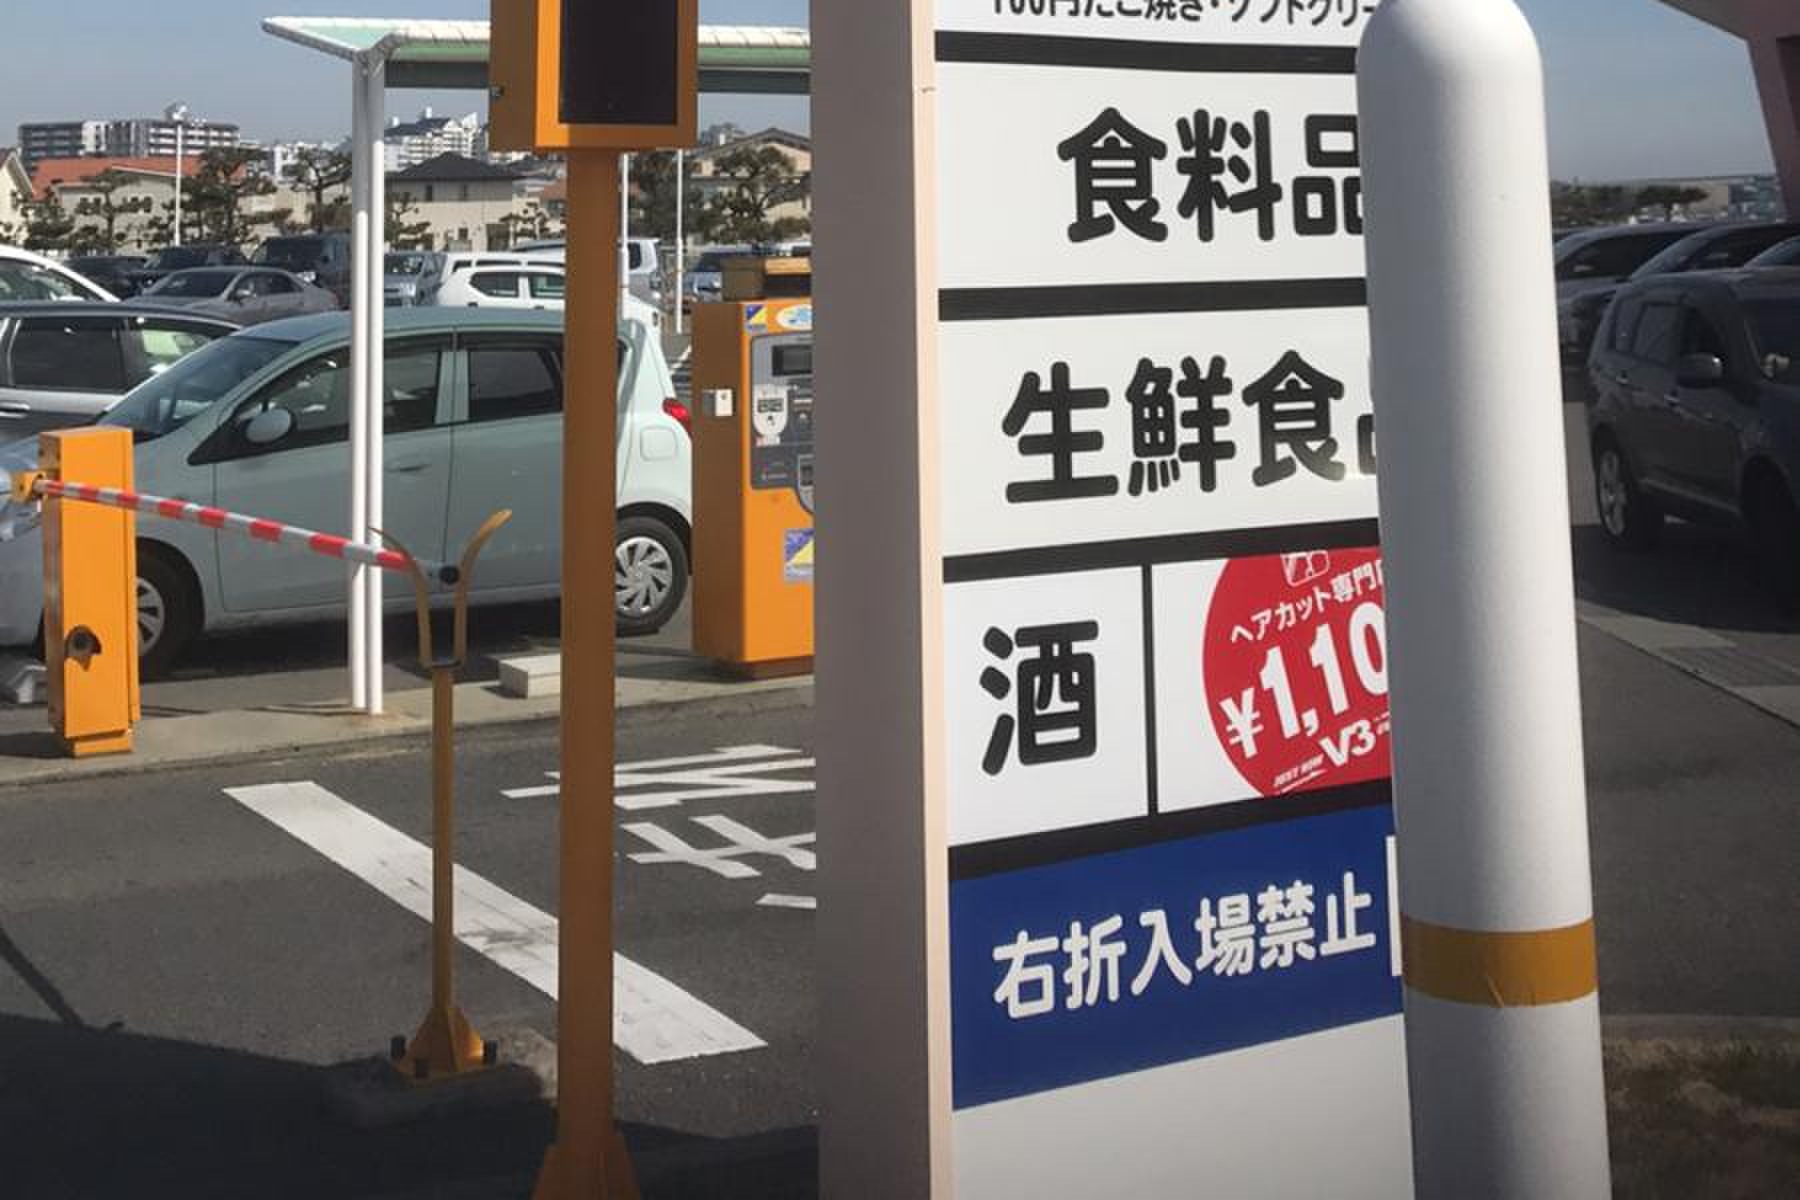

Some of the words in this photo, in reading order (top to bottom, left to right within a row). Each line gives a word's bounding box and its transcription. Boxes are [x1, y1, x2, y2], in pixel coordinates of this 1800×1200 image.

[1057, 107, 1364, 242] 食料品
[1002, 350, 1376, 503] 生鮮食
[1231, 560, 1382, 643] ヘアカット専門
[980, 620, 1099, 777] 酒
[1318, 719, 1376, 767] V3
[992, 871, 1376, 1019] 右折入場禁止
